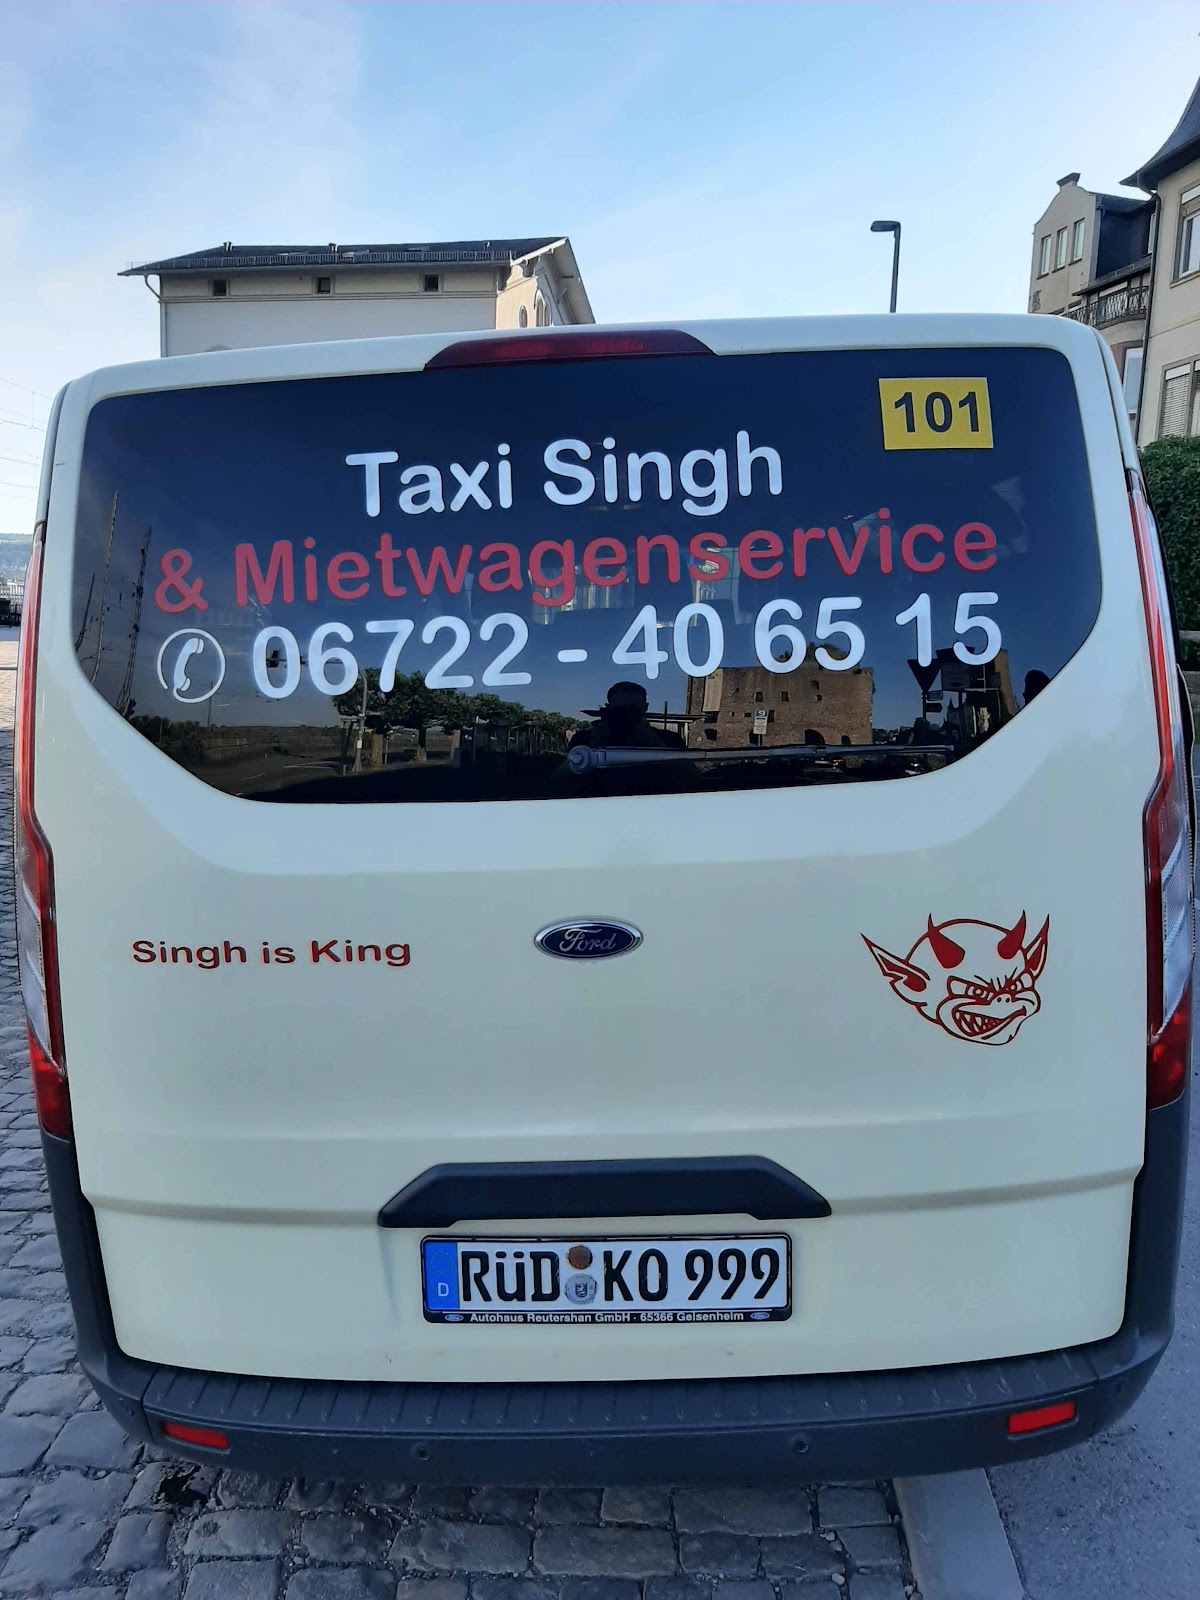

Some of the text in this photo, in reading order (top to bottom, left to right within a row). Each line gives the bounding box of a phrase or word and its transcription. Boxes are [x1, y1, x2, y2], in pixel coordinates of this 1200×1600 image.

[894, 391, 980, 433] 101
[345, 430, 782, 517] Taxi Singh
[154, 508, 998, 613] & Mietwagenservice
[252, 612, 533, 699] 06722
[612, 602, 724, 680] 40
[754, 596, 866, 674] 65
[895, 591, 1002, 668] 15
[132, 940, 411, 970] Singh is King
[559, 928, 617, 952] Ford
[437, 1282, 450, 1297] D
[603, 1248, 668, 1302] KO
[684, 1247, 780, 1301] 999
[470, 1312, 524, 1322] Autohaus
[527, 1312, 592, 1322] Reutershan
[595, 1311, 630, 1322] GmbH
[640, 1312, 673, 1322] 65366
